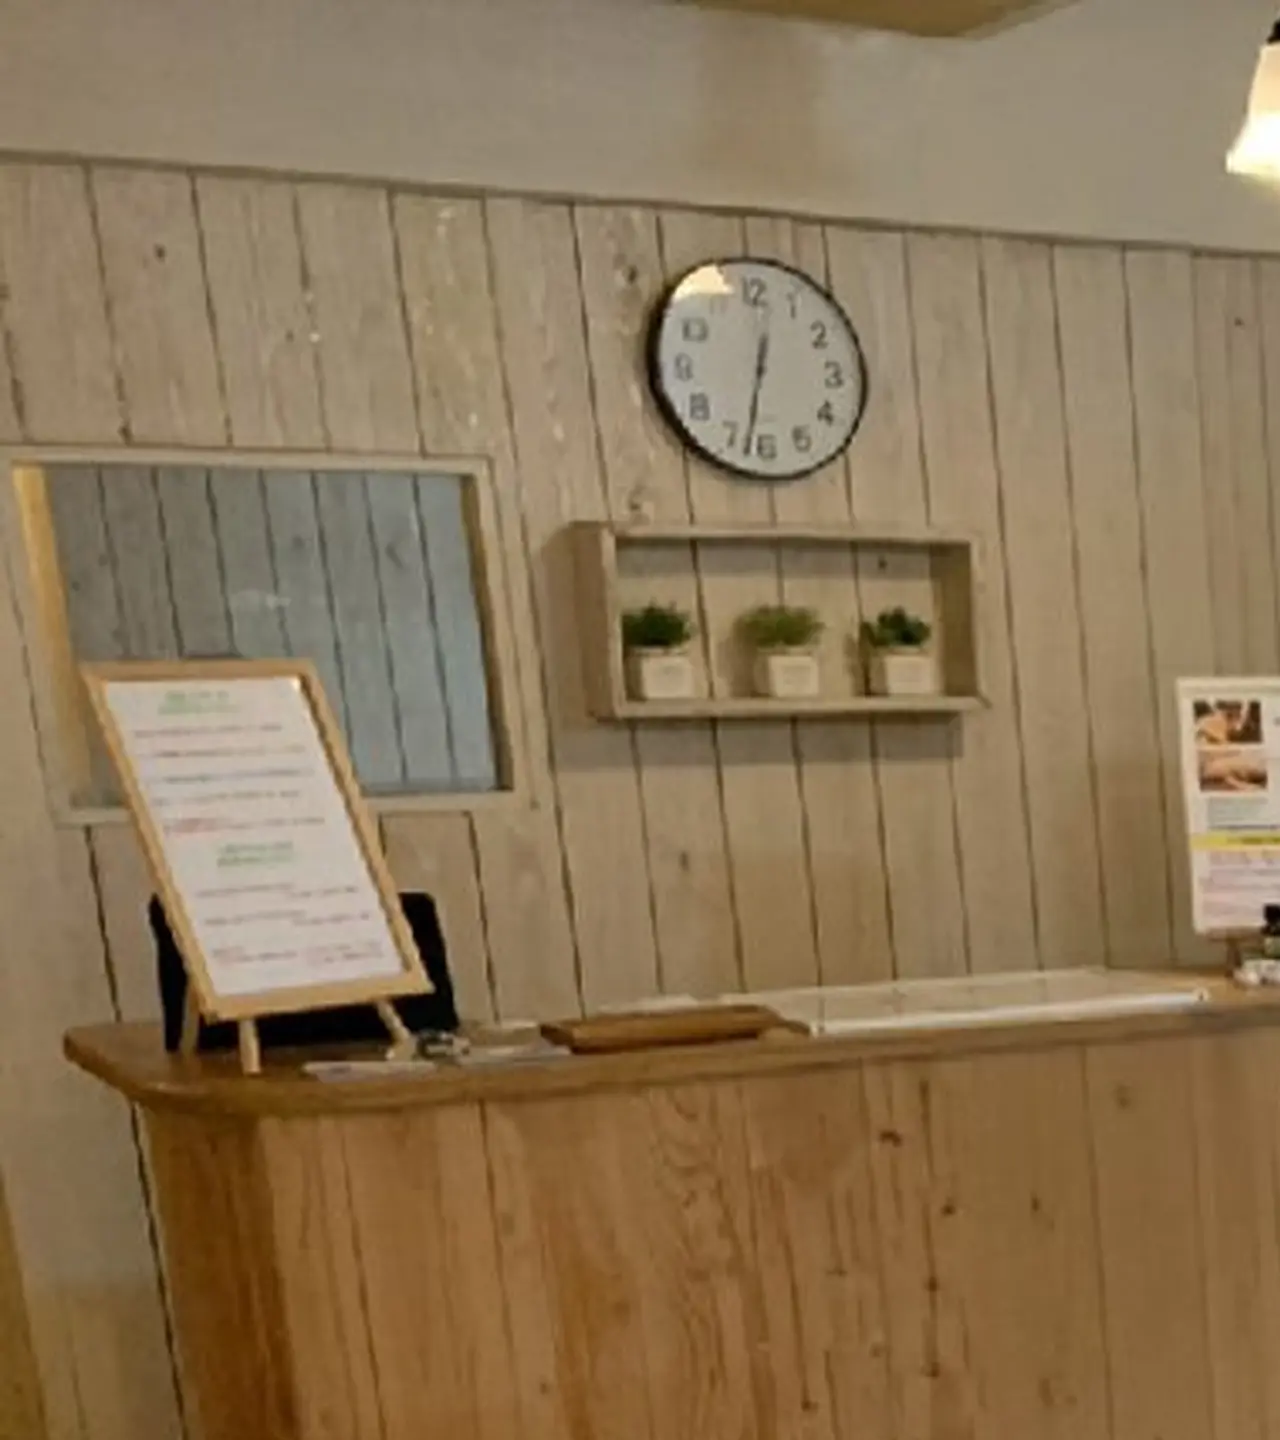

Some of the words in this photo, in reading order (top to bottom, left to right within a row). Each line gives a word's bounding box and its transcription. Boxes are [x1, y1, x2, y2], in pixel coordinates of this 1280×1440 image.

[742, 277, 767, 307] 12
[810, 321, 828, 350] 2
[824, 361, 843, 388] 3
[817, 400, 834, 426] 4
[722, 421, 738, 447] 7
[757, 434, 777, 460] 6
[792, 425, 812, 451] 5
